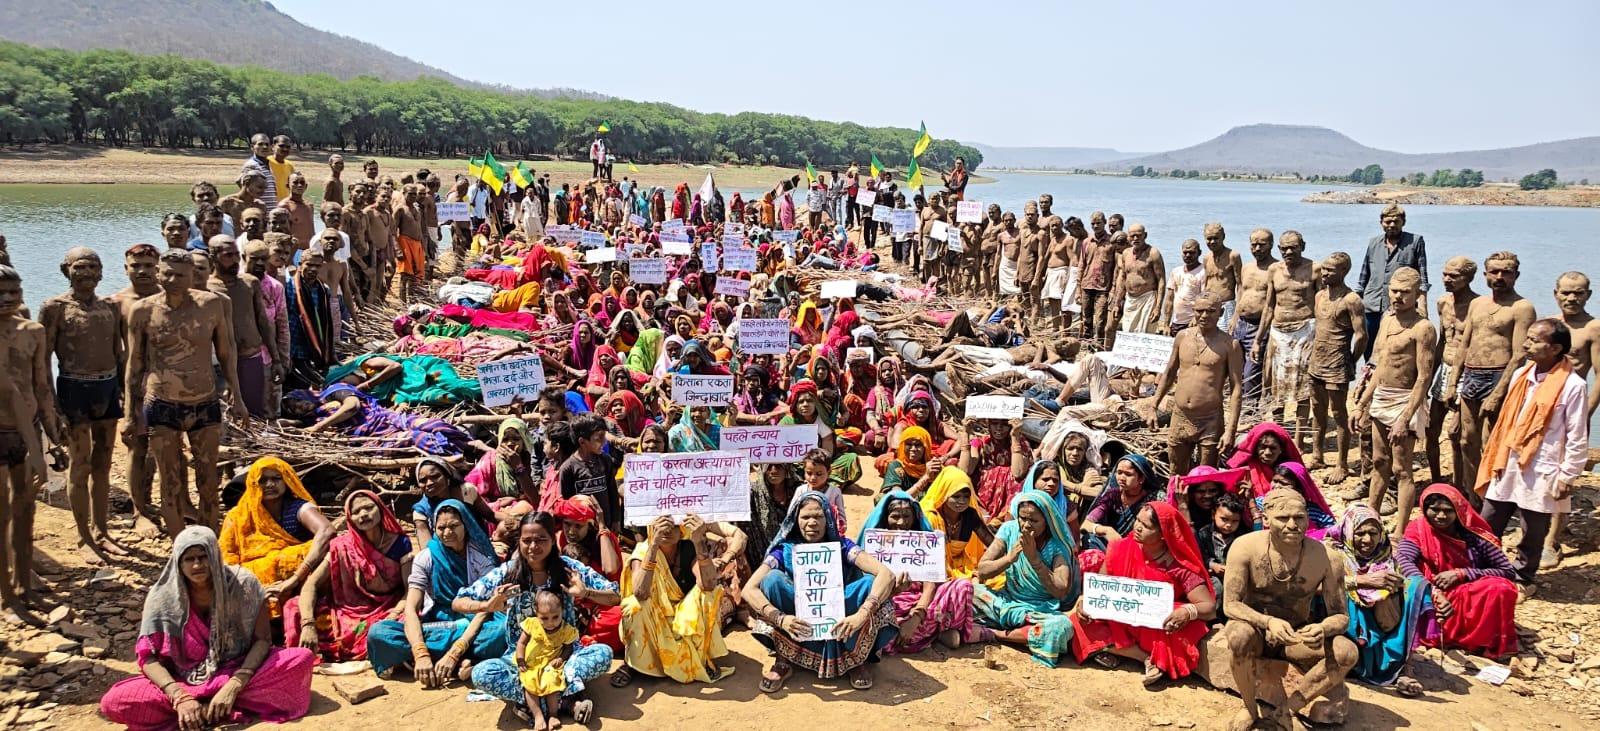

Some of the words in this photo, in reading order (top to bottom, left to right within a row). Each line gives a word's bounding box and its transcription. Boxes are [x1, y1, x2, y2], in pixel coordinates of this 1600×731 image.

[675, 375, 704, 387] किसान
[707, 378, 733, 388] एकता
[487, 387, 515, 398] अन्याय
[684, 390, 732, 405] जिन्दाबाद
[723, 428, 751, 443] पहले
[751, 429, 781, 440] न्याय
[661, 458, 693, 471] करता
[693, 457, 745, 469] अत्याचार
[652, 473, 689, 490] चाहिये
[690, 474, 731, 488] न्याय
[656, 494, 708, 509] अधिकार
[867, 534, 899, 548] न्याय
[925, 533, 938, 549] तो
[796, 545, 836, 565] जागो
[805, 568, 829, 587] कि
[806, 587, 827, 602] सा
[1121, 583, 1135, 594] का
[1135, 581, 1163, 597] शोषण
[808, 603, 826, 618] न
